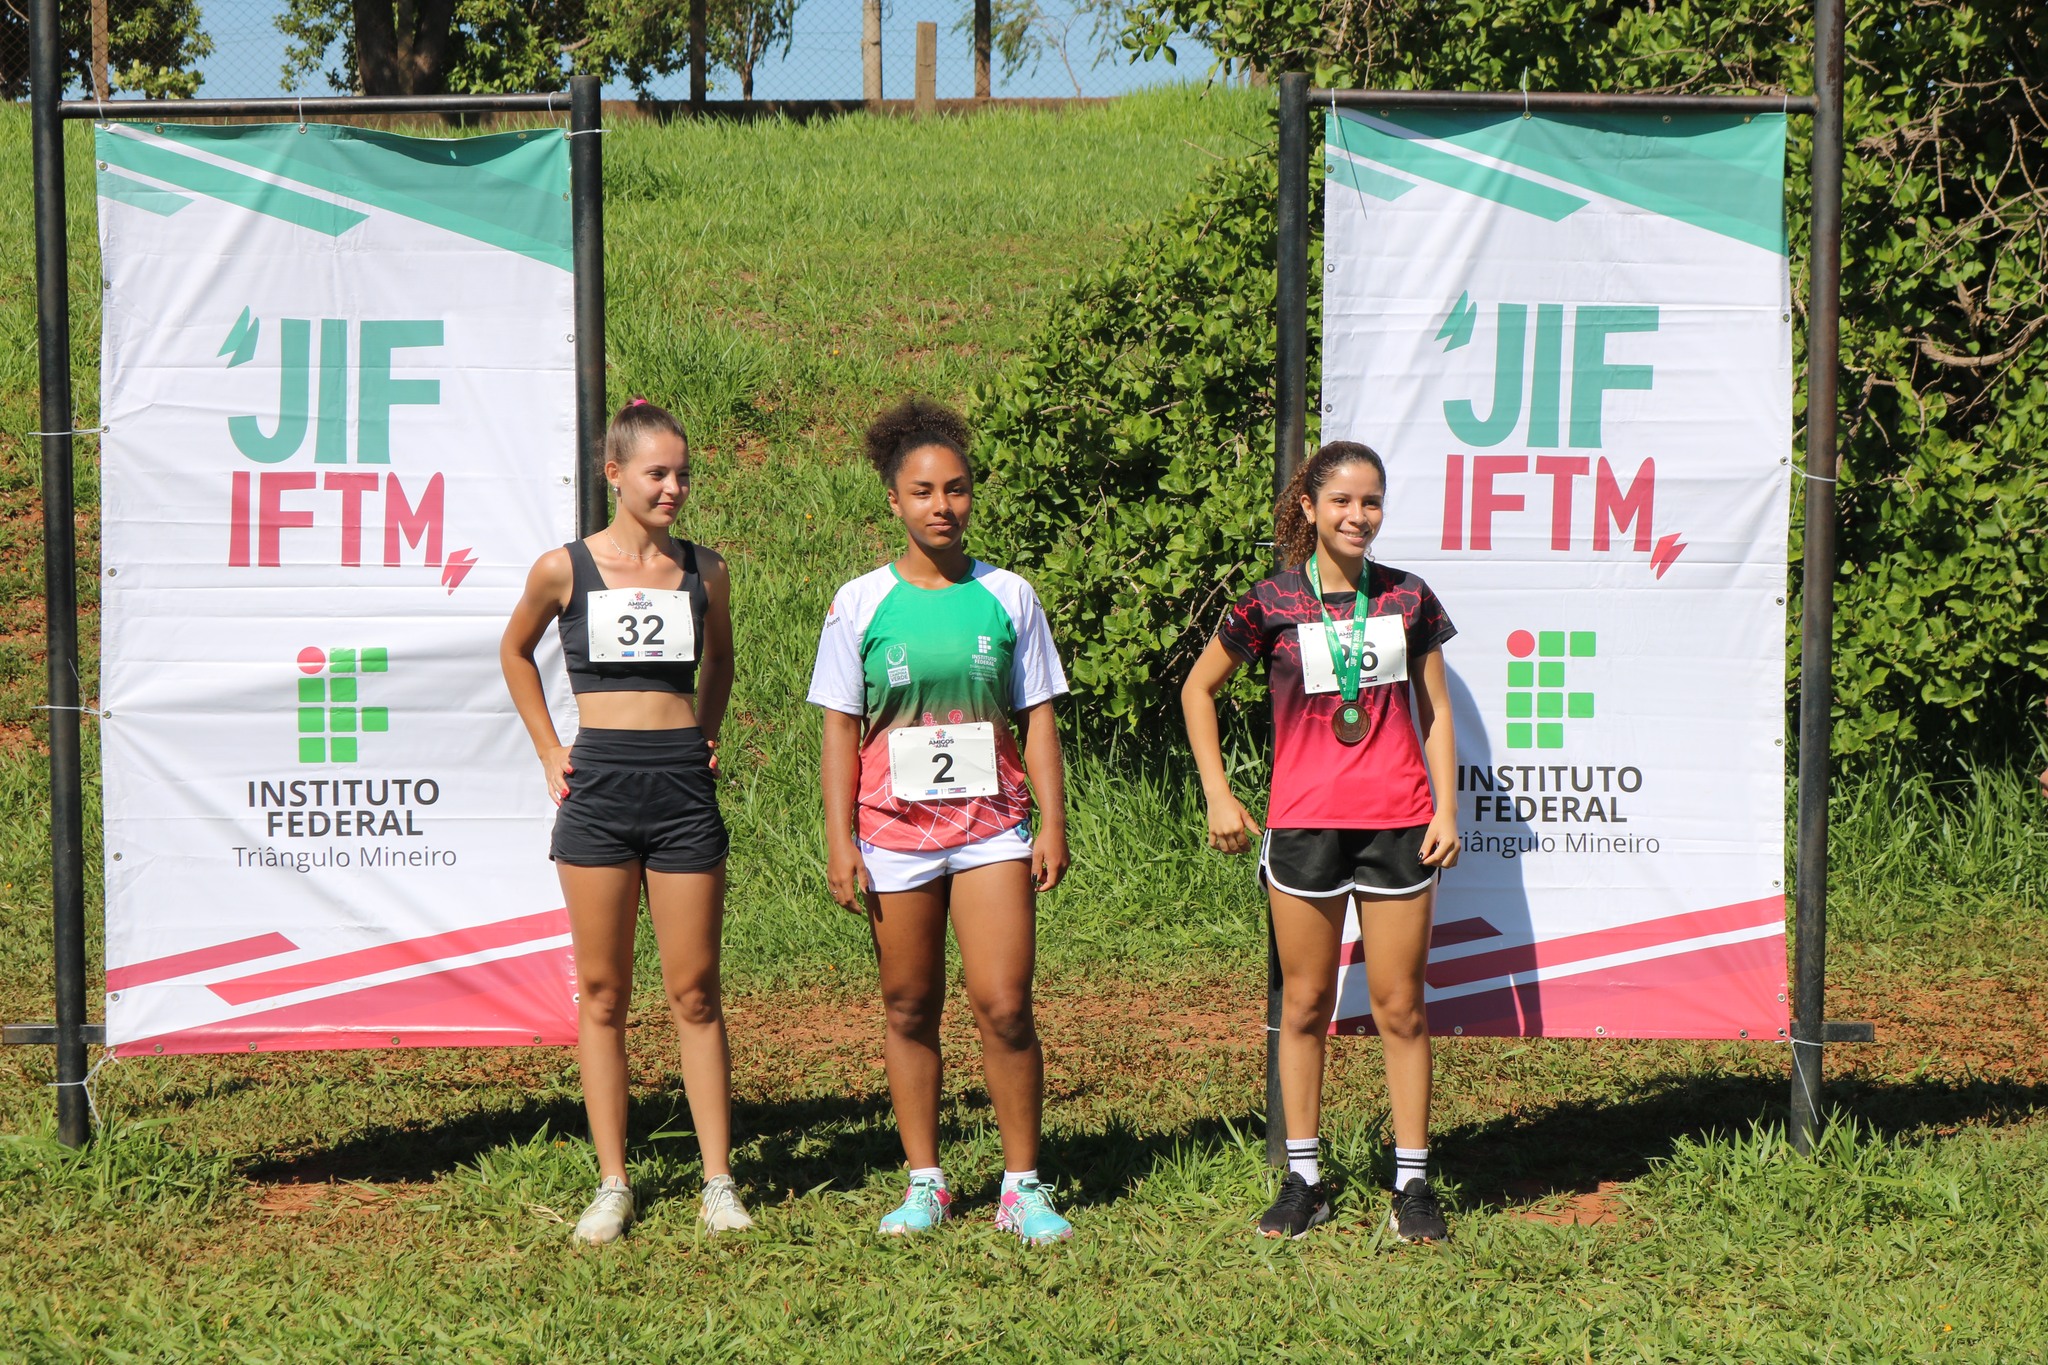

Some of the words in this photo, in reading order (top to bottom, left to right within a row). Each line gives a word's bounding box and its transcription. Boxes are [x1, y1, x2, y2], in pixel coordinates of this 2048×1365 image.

[1442, 302, 1660, 449] JIF
[227, 318, 445, 464] JIF
[1441, 454, 1656, 552] IFTM
[228, 470, 445, 567] IFTM
[617, 615, 665, 646] 32
[971, 654, 998, 662] INSTITUTO
[928, 738, 955, 746] AMIGOS
[932, 753, 955, 784] 2
[1458, 765, 1643, 793] INSTITUTO
[248, 778, 440, 808] INSTITUTO
[267, 809, 424, 838] FEDERAL
[1475, 796, 1628, 823] FEDERAL
[1458, 830, 1556, 859] iângulo
[1565, 832, 1660, 854] Mineiro
[232, 846, 350, 874] Triângulo
[360, 845, 457, 867] Mineiro
